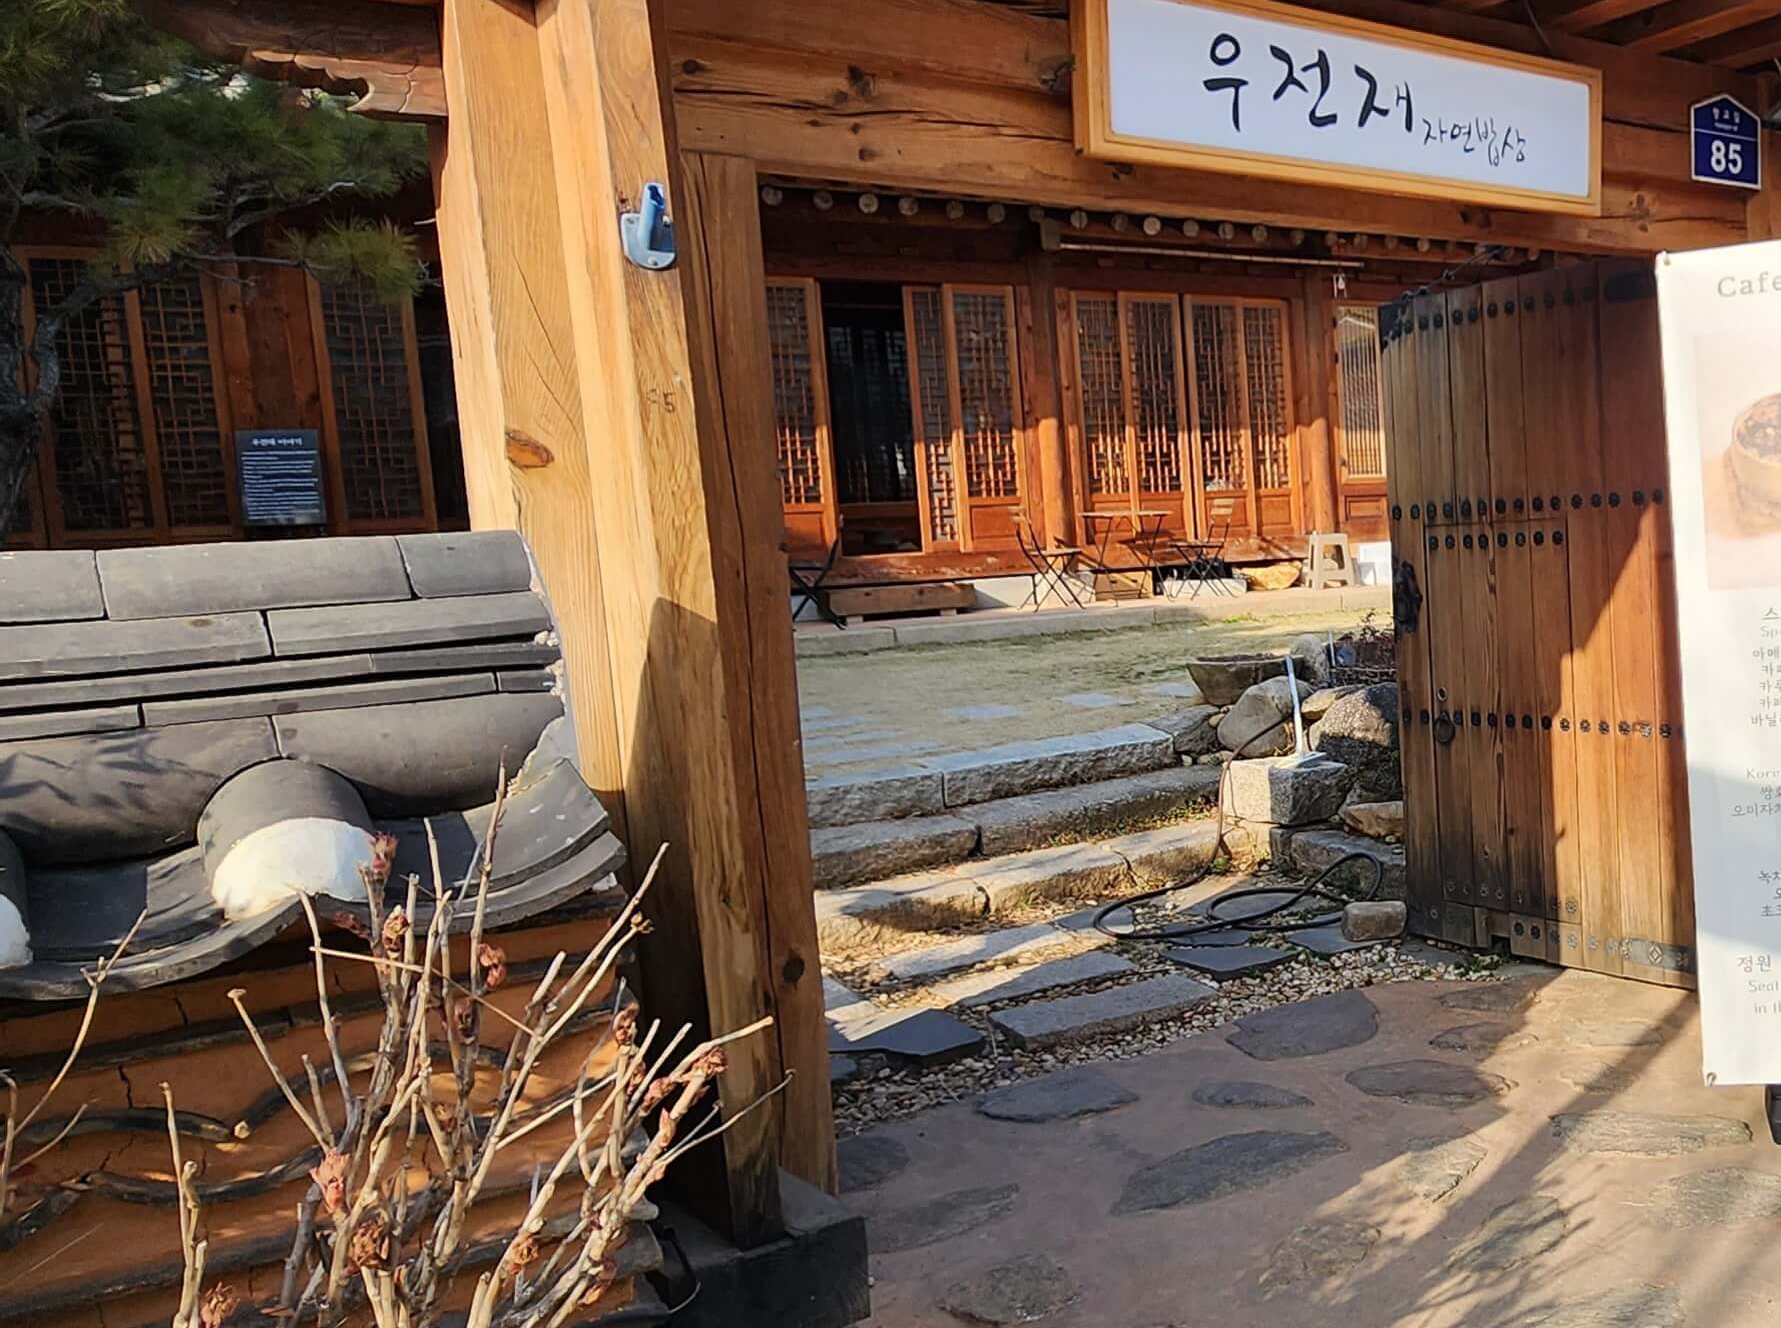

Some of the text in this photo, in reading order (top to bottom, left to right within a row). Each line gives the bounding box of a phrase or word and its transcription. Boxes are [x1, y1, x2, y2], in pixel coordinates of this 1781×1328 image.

[1202, 33, 1413, 133] 우전재
[1422, 117, 1527, 167] 자연밥상
[1710, 139, 1743, 175] 85
[1751, 712, 1781, 727] 바닐
[1736, 955, 1772, 972] 정원
